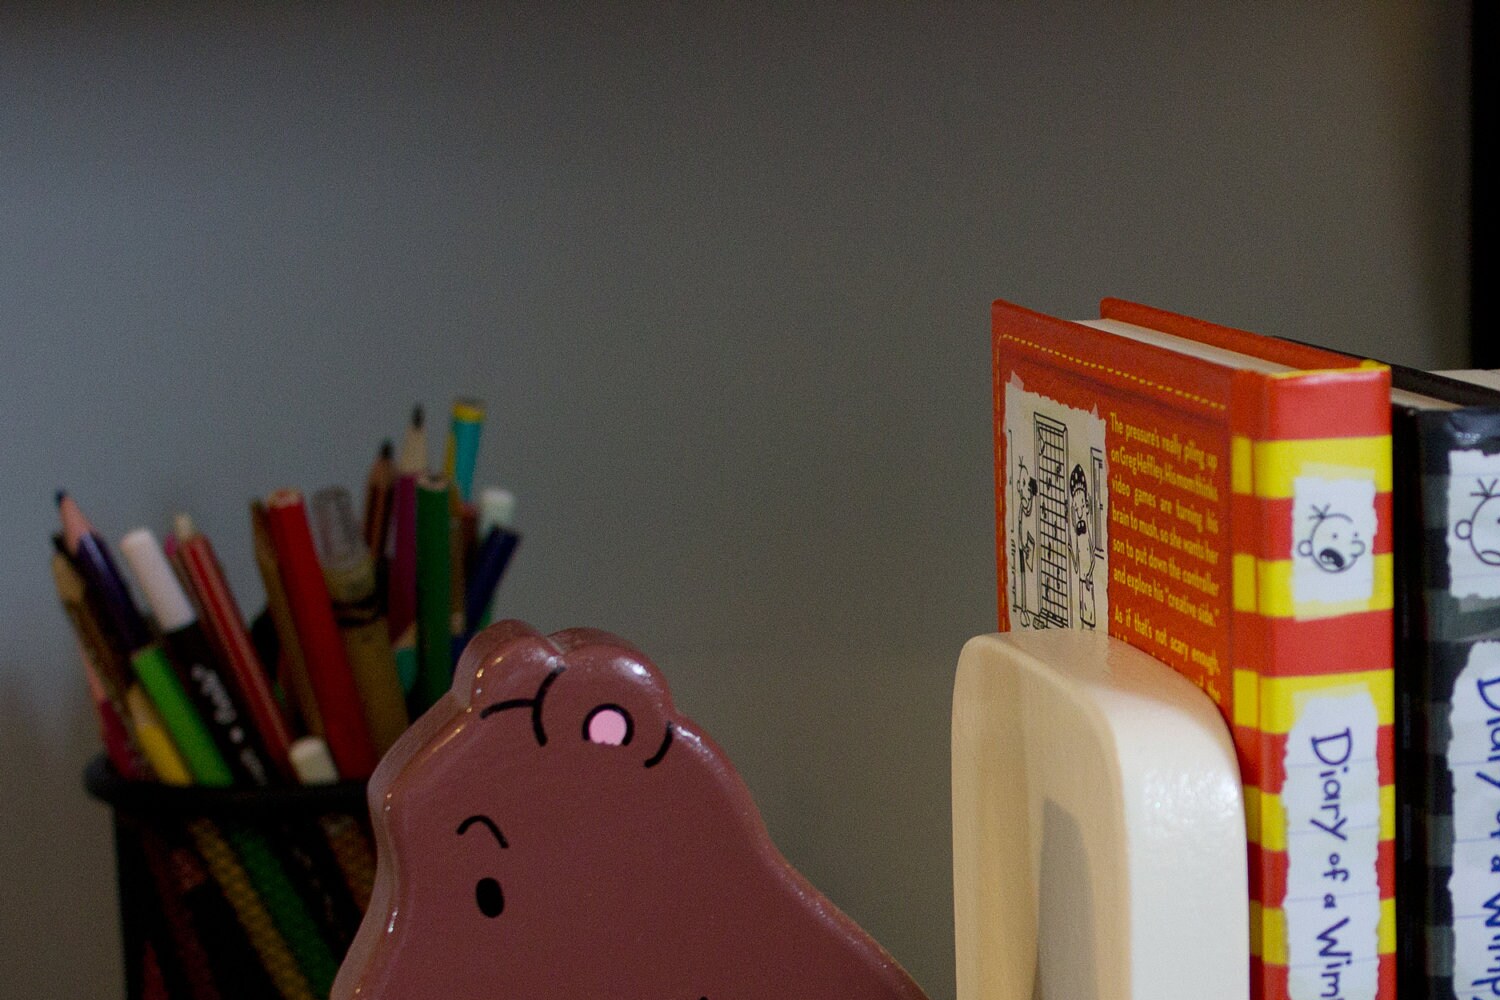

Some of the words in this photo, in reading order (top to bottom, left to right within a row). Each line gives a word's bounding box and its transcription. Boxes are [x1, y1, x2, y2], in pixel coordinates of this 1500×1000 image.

[1110, 411, 1123, 434] The
[1111, 449, 1120, 462] on
[1120, 446, 1137, 476] Greg
[1112, 473, 1130, 497] video
[1134, 487, 1156, 508] games
[1112, 501, 1130, 528] brain
[1130, 511, 1138, 532] to
[1113, 538, 1125, 555] son
[1126, 539, 1134, 559] to
[1135, 546, 1148, 566] put
[1148, 547, 1168, 574] down
[1113, 565, 1126, 585] and
[1127, 572, 1153, 597] explore
[1115, 604, 1123, 625] As
[1126, 607, 1131, 628] if
[1310, 727, 1353, 841] Diary
[1323, 853, 1348, 882] of
[1324, 894, 1336, 909] a
